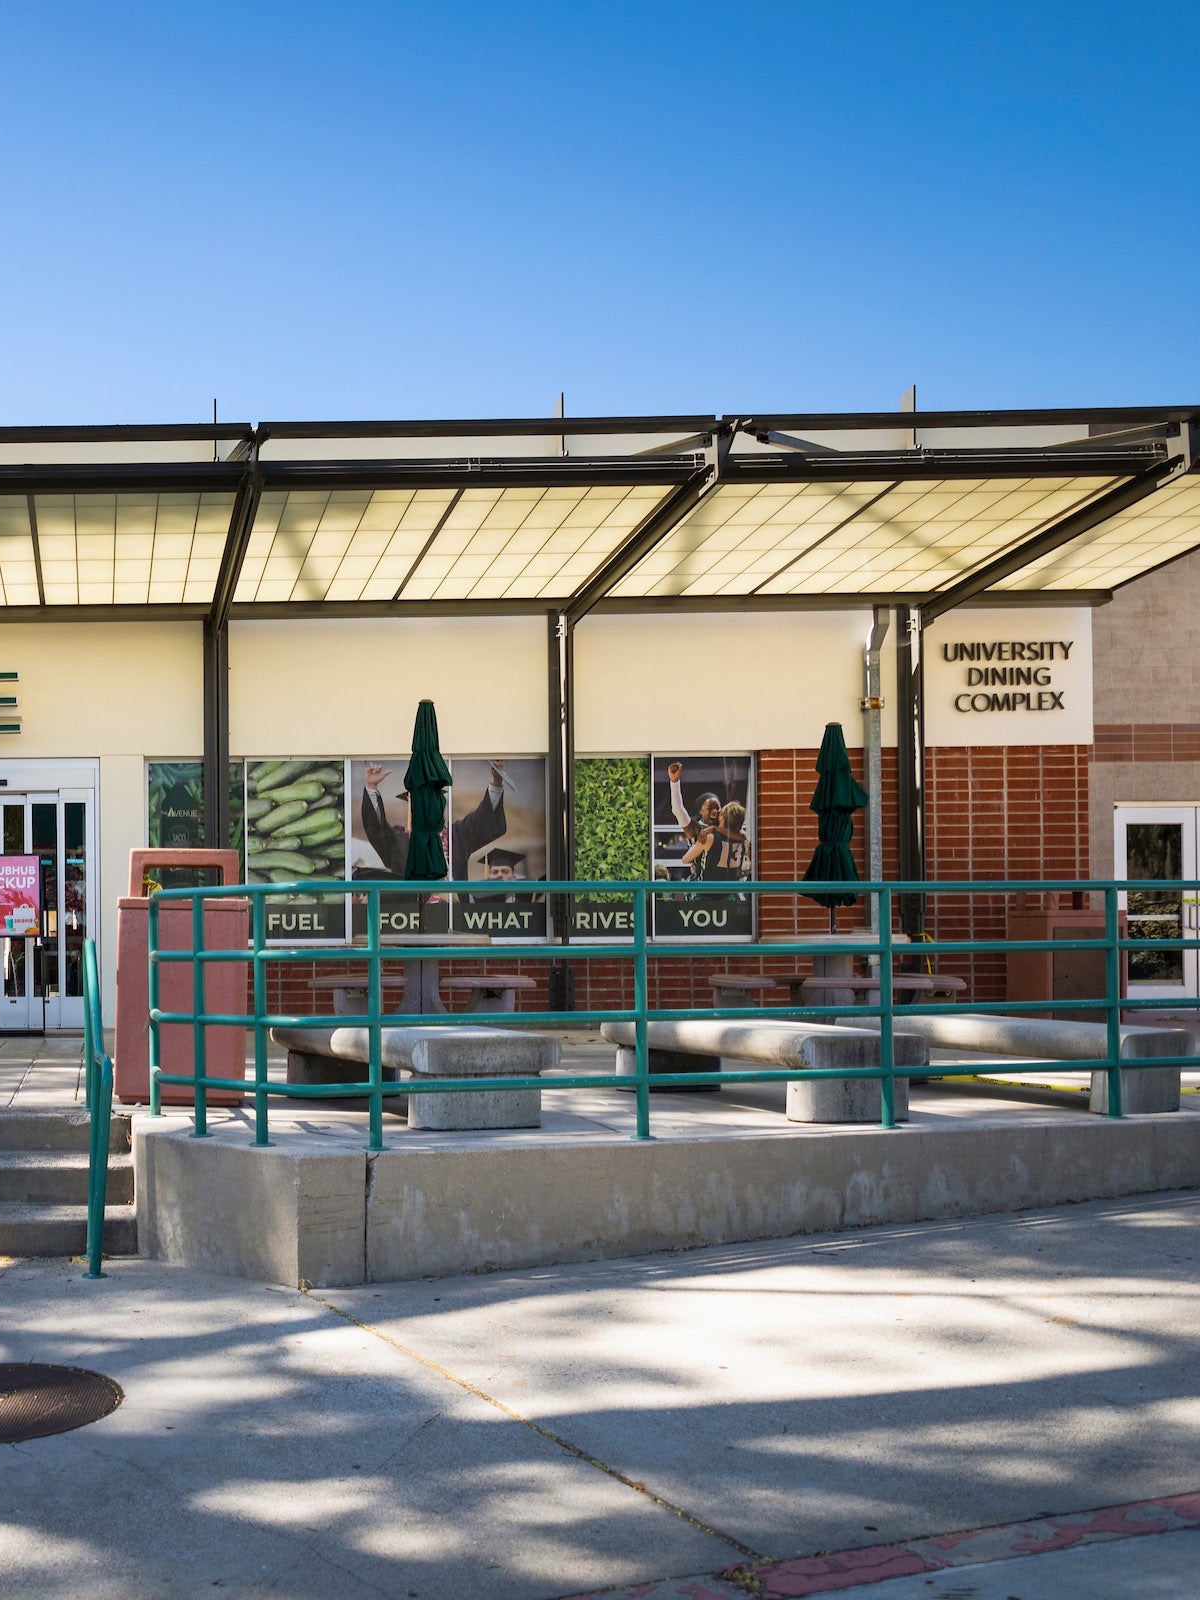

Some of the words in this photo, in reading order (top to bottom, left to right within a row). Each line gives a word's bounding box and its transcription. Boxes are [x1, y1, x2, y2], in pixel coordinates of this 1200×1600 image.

[943, 641, 1074, 662] UNIVERSITY
[967, 667, 1052, 687] DINING
[954, 691, 1065, 713] COMPLEX
[268, 913, 325, 931] FUEL
[464, 911, 533, 929] WHAT
[679, 910, 728, 927] YOU
